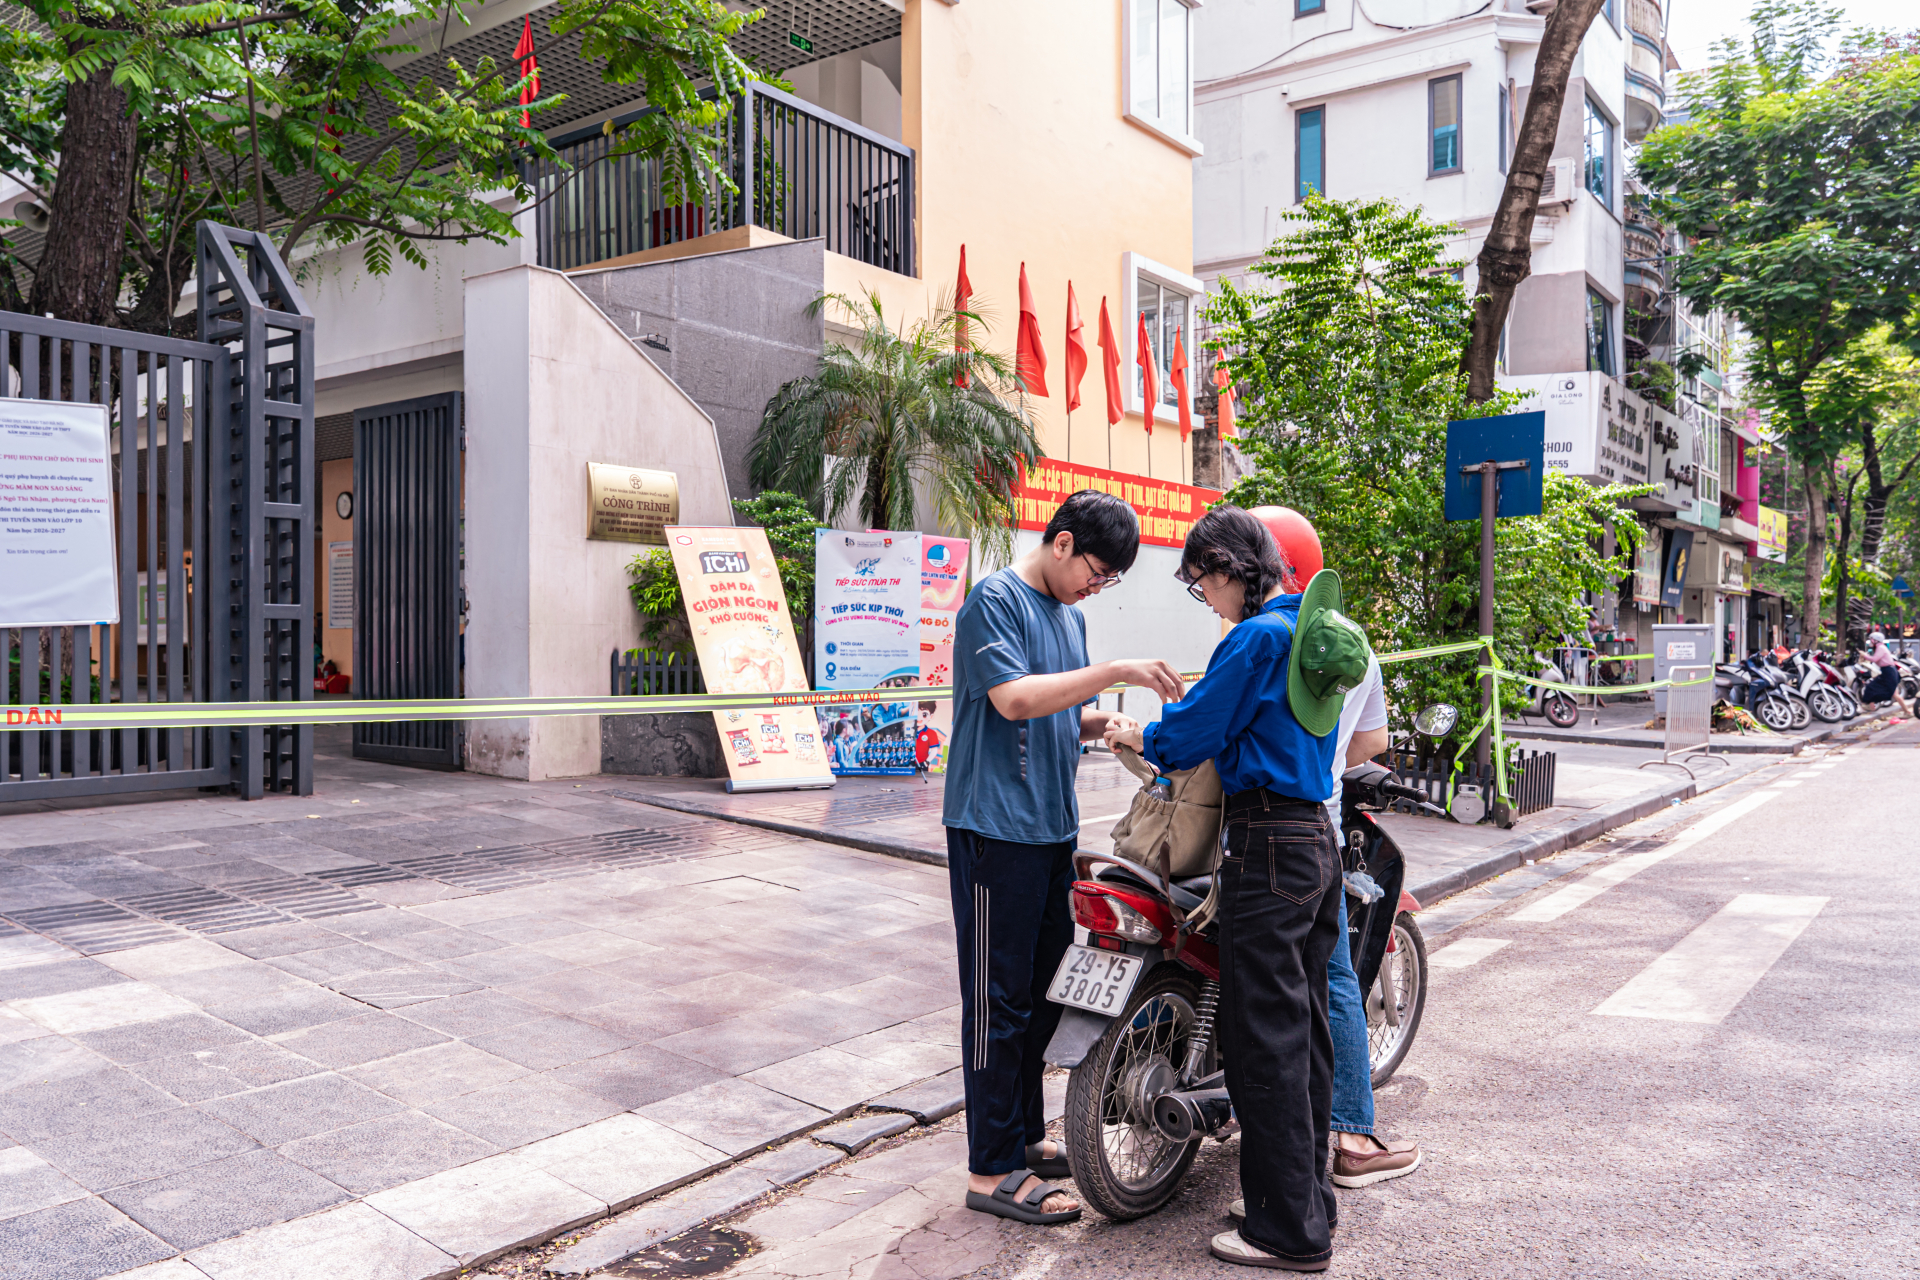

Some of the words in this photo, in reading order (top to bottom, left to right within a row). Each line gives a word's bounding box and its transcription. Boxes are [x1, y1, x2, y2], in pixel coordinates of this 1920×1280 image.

[1046, 465, 1060, 492] CÁC
[1061, 468, 1072, 494] THÍ
[1133, 484, 1145, 508] TIN,
[1146, 486, 1157, 511] ĐẠT
[1158, 484, 1168, 509] KẾT
[1169, 486, 1180, 512] QUẢ
[1181, 493, 1191, 514] CAO
[603, 495, 634, 509] CÔNG
[636, 499, 670, 513] TRÌNH
[1025, 498, 1036, 522] THI
[1143, 509, 1153, 536] TỐT
[1154, 515, 1174, 543] NGHIỆP
[710, 581, 737, 593] ĐẬM
[835, 576, 850, 586] TIẾP
[851, 577, 867, 586] SỨC
[868, 577, 887, 586] MÙA
[693, 596, 730, 613] GIÒN
[735, 596, 778, 612] NGON
[831, 602, 848, 614] TIẾP
[850, 602, 866, 612] SỨC
[868, 604, 882, 613] KỊP
[885, 606, 904, 618] THỜI
[709, 612, 730, 625] KHÓ
[734, 612, 769, 623] CƯỠNG
[934, 617, 949, 628] ĐỎ
[773, 696, 797, 705] KHU
[802, 693, 825, 705] VỰC
[830, 691, 854, 703] CẤM
[858, 691, 880, 702] VÀO
[6, 707, 62, 725] DÂN
[1070, 950, 1130, 982] 29-Y5
[1059, 976, 1119, 1009] 3805
